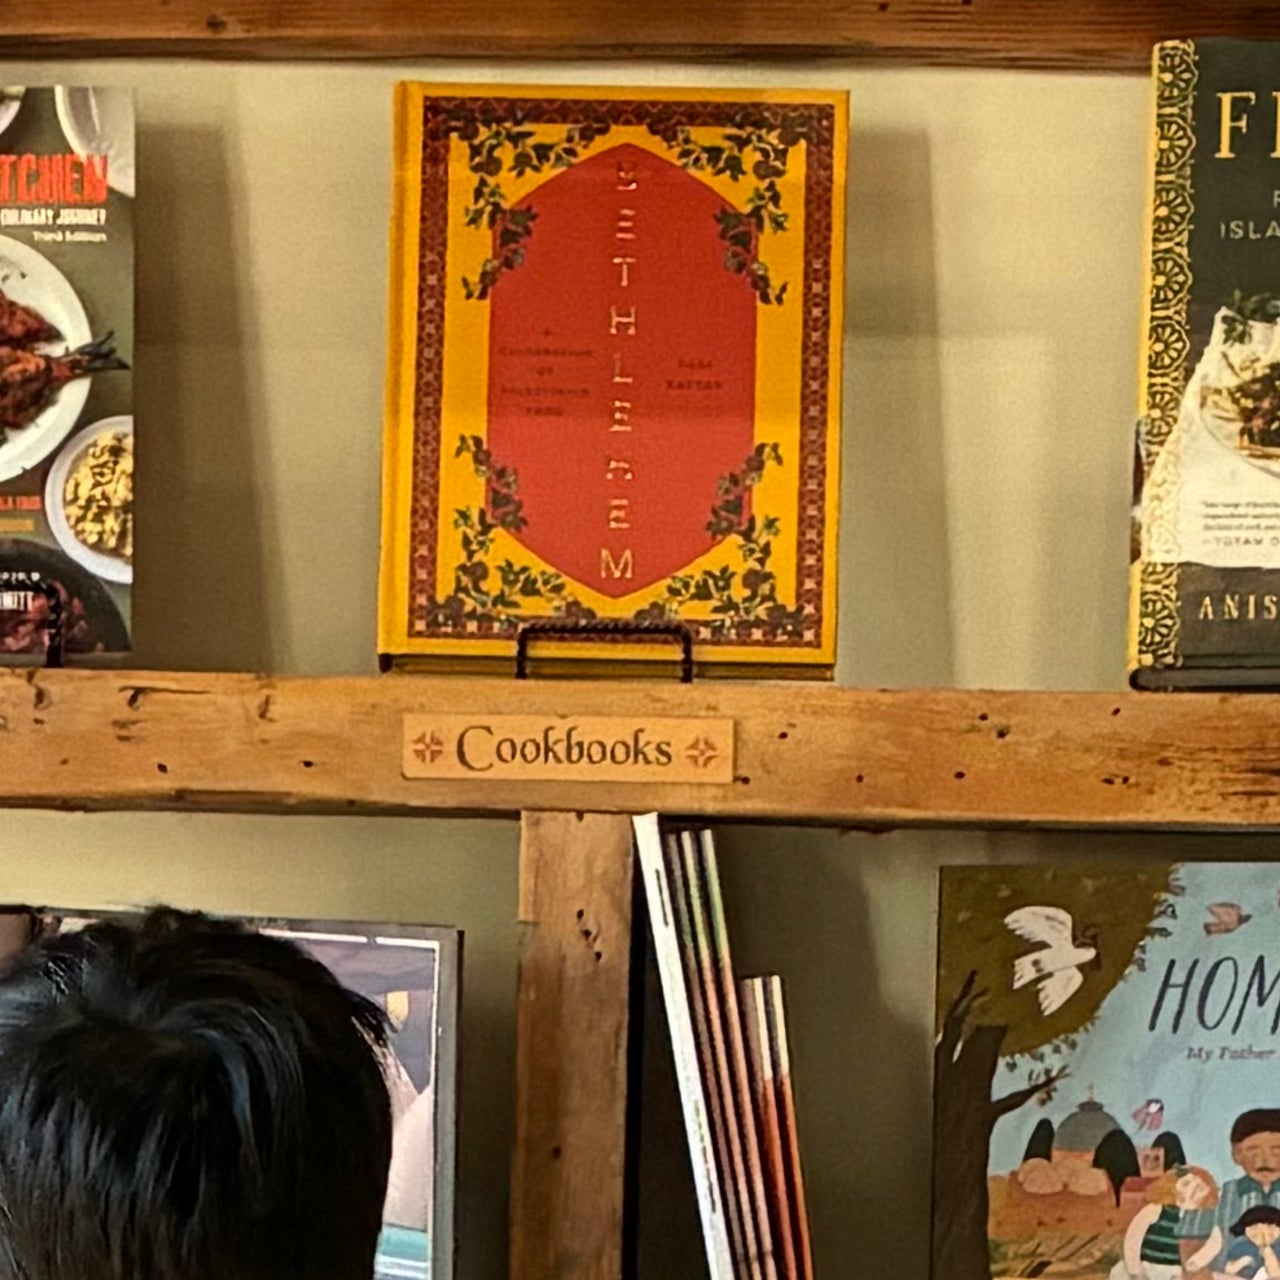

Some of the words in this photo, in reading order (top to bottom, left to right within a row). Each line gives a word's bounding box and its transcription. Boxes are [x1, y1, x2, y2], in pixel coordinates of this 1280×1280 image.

[456, 725, 673, 772] Cookbooks
[1187, 1046, 1211, 1062] My
[1219, 1046, 1274, 1061] Father
